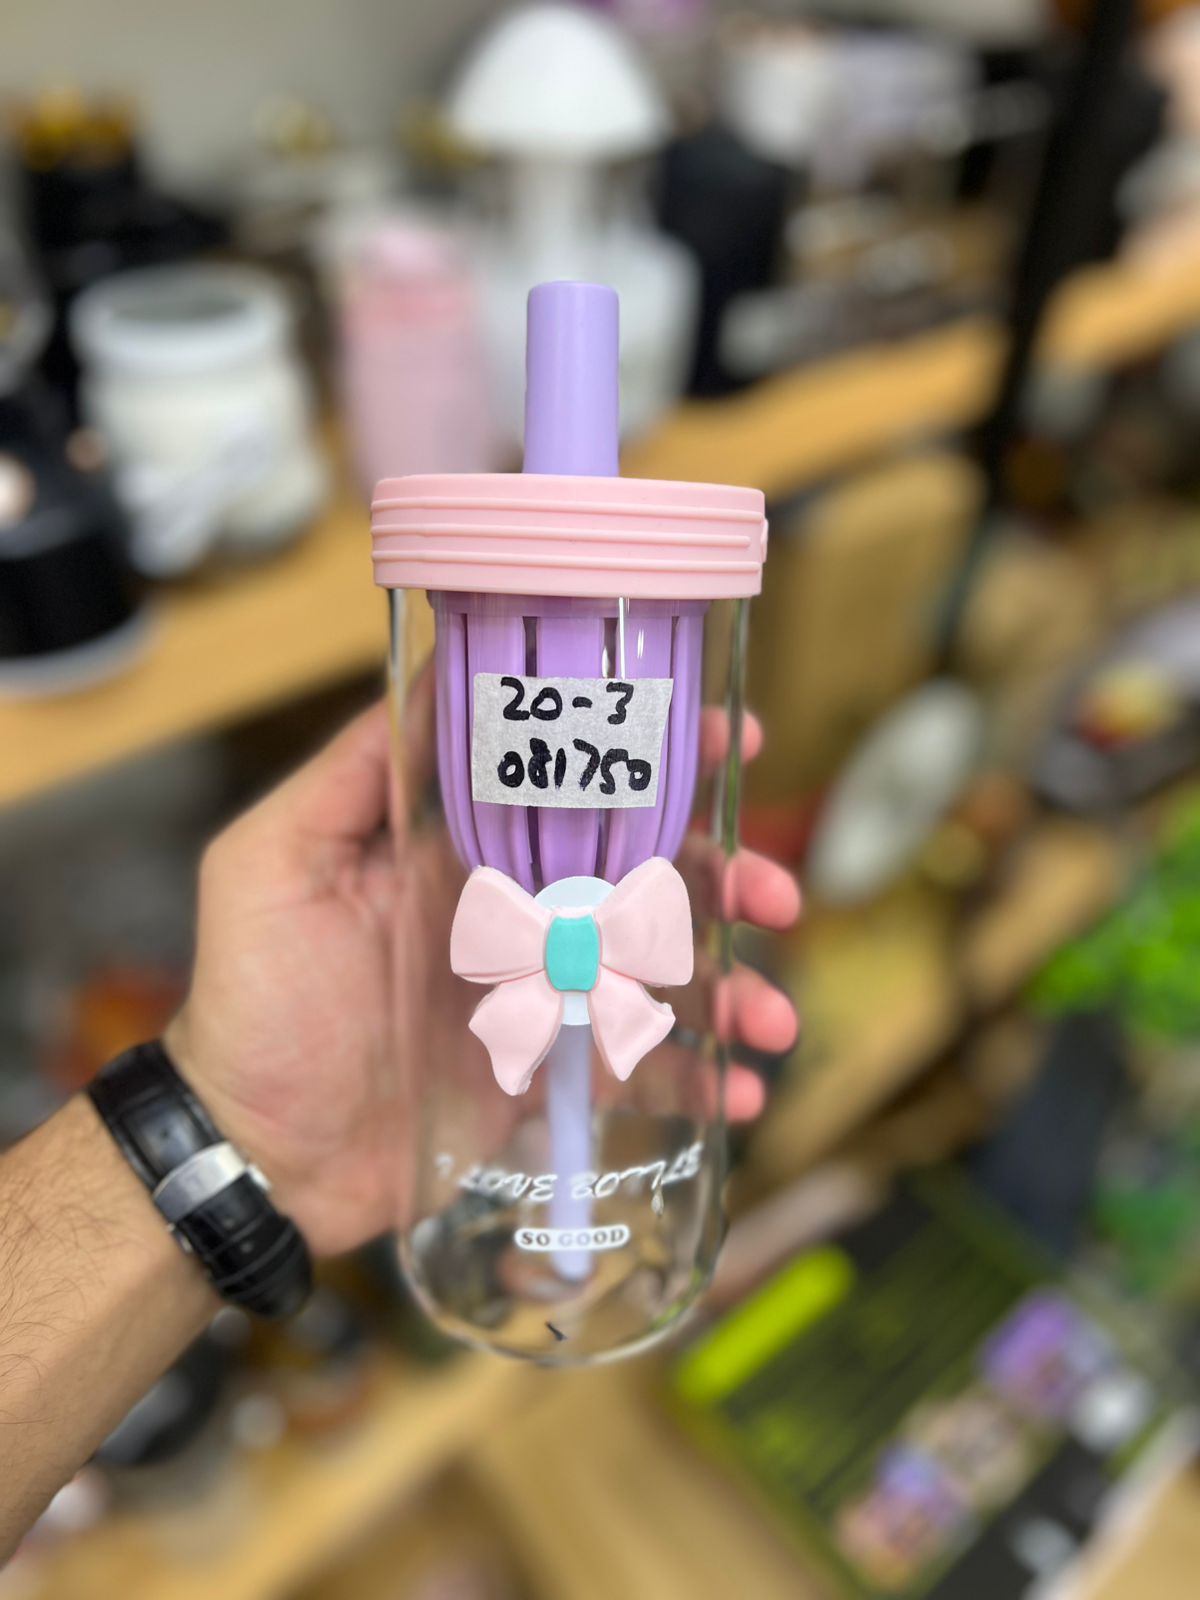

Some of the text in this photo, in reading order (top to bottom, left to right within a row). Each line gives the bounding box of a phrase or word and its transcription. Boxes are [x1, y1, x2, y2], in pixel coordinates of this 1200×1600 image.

[501, 676, 634, 725] 20-3
[498, 737, 652, 795] 081750
[521, 1228, 625, 1247] SO GOOD
